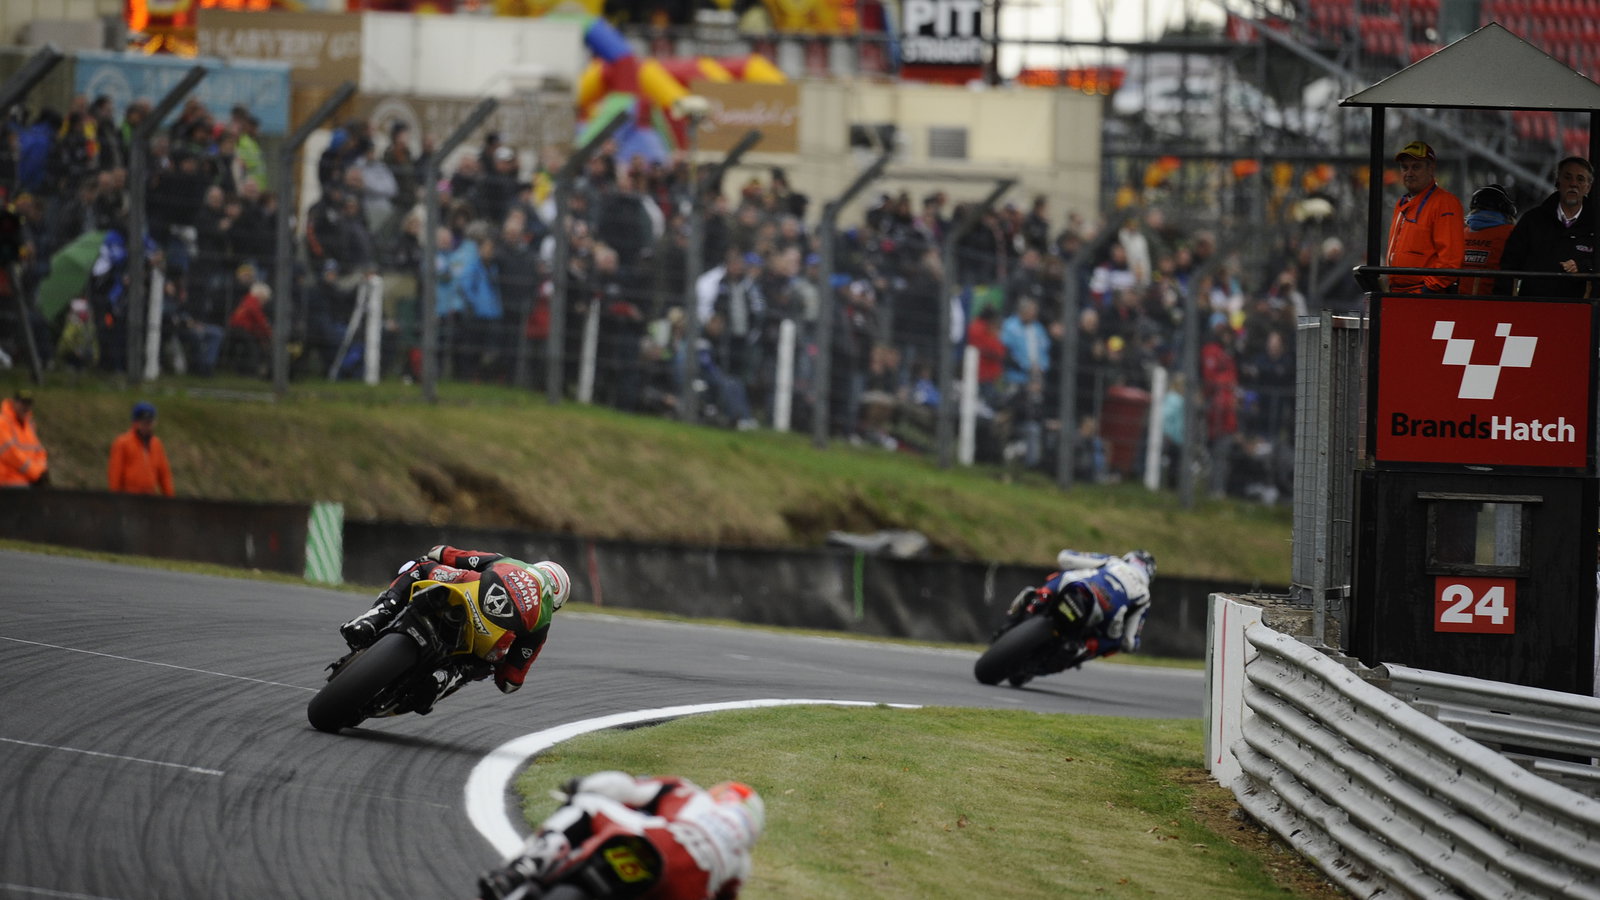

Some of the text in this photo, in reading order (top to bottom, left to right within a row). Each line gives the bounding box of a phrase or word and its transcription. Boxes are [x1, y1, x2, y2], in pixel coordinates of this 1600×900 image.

[902, 0, 980, 37] PIT
[1390, 411, 1576, 443] BrandsHatch
[508, 571, 533, 612] YAMAHA
[516, 570, 539, 606] SWAN
[1440, 584, 1509, 625] 24
